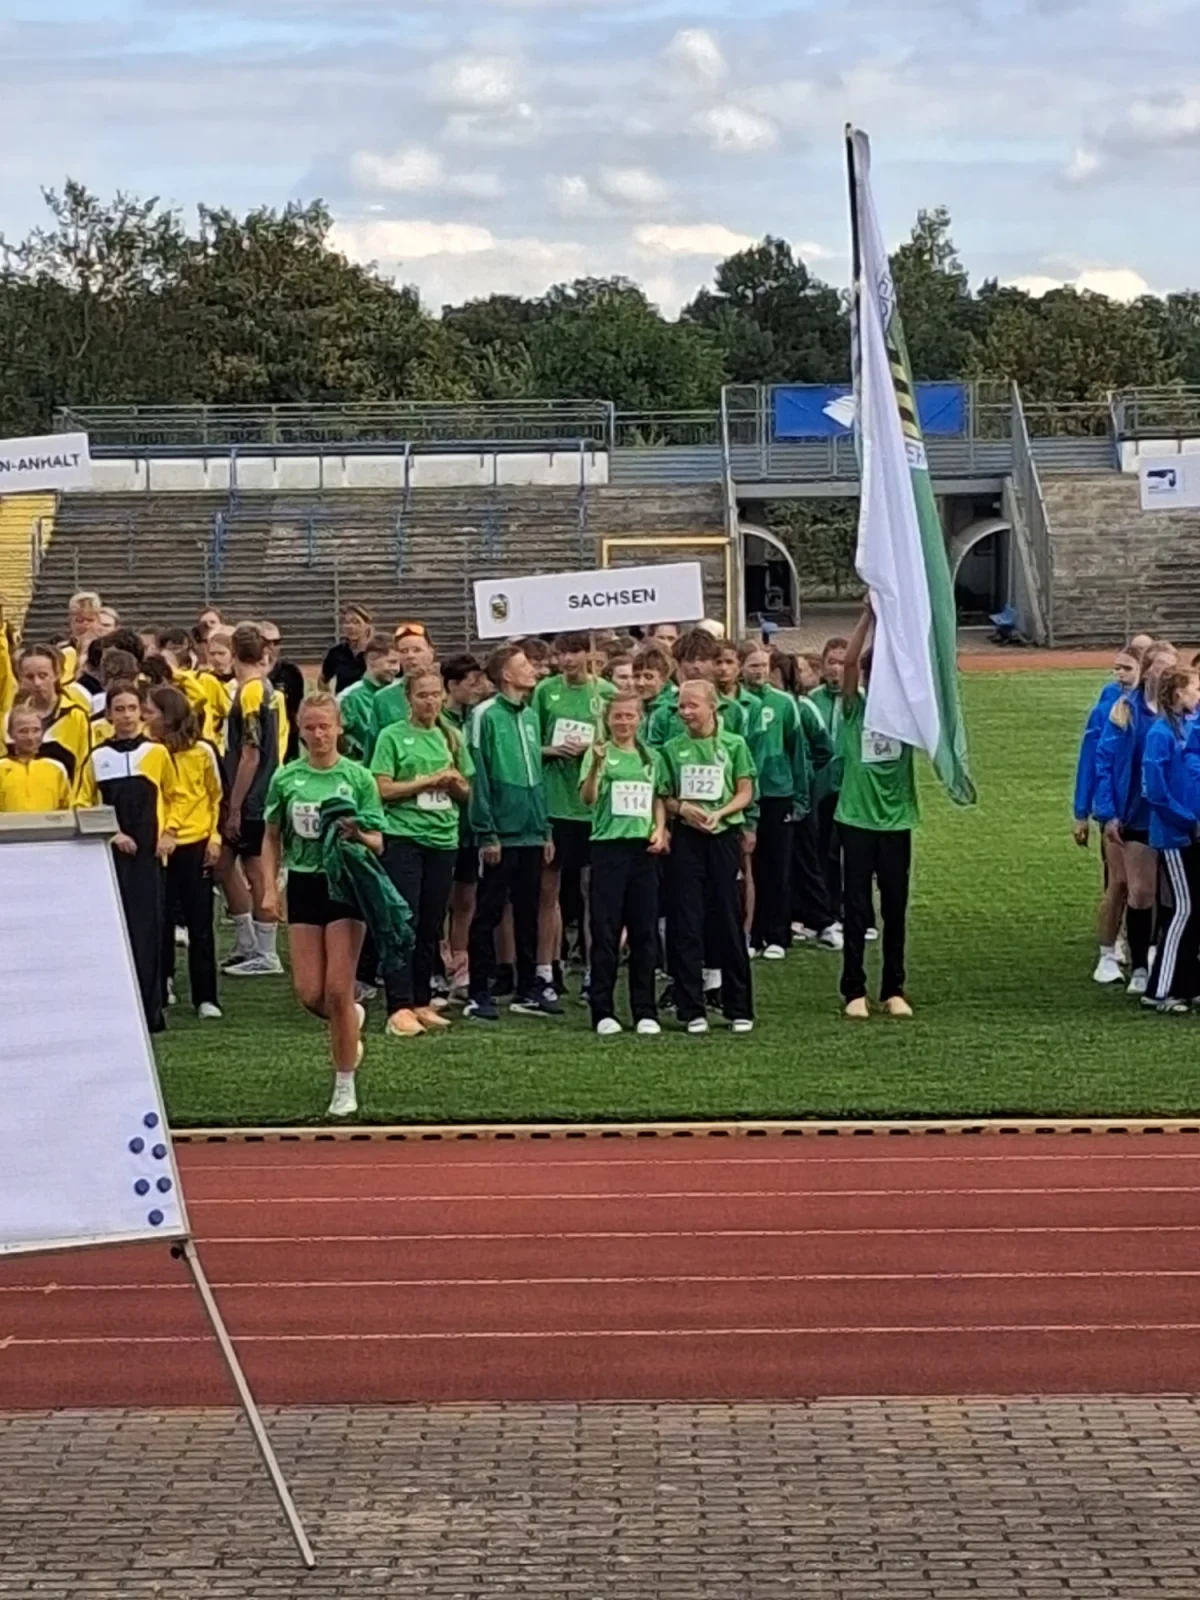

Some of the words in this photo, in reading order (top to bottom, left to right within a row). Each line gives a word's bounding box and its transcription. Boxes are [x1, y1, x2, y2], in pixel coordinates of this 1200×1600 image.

[568, 588, 656, 609] SACHSEN
[687, 780, 715, 794] 122
[623, 796, 647, 809] 114
